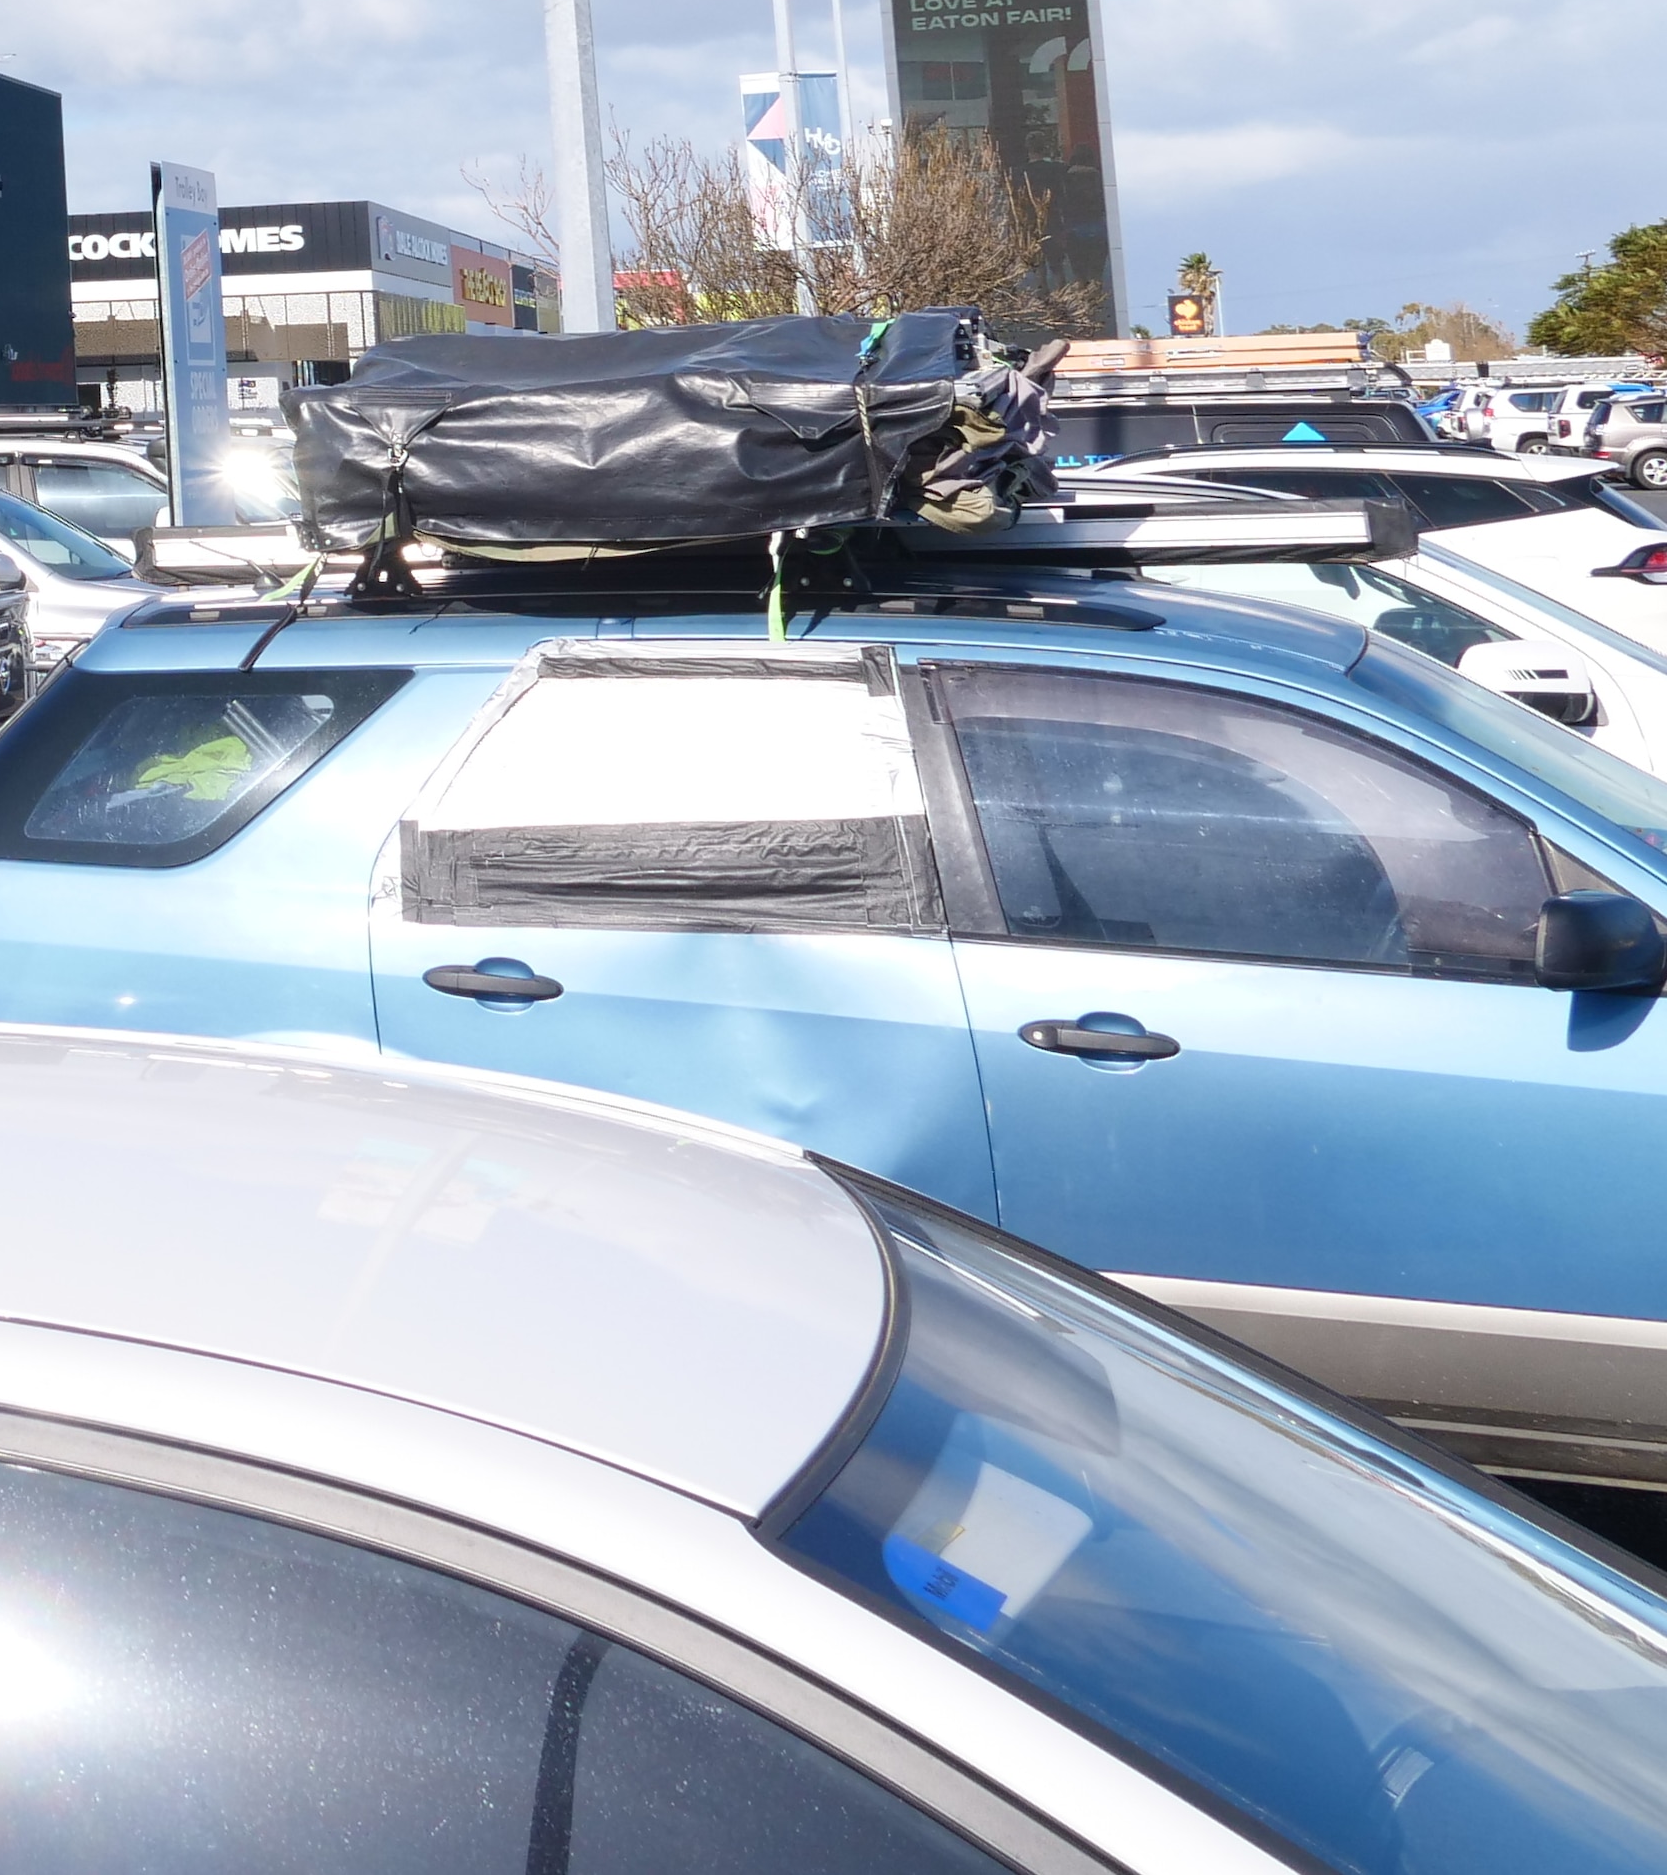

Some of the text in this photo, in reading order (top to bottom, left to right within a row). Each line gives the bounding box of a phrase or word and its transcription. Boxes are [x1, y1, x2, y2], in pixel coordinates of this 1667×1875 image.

[912, 7, 1072, 31] EATON FAIR!
[174, 175, 197, 206] Trolley
[218, 225, 305, 254] MES
